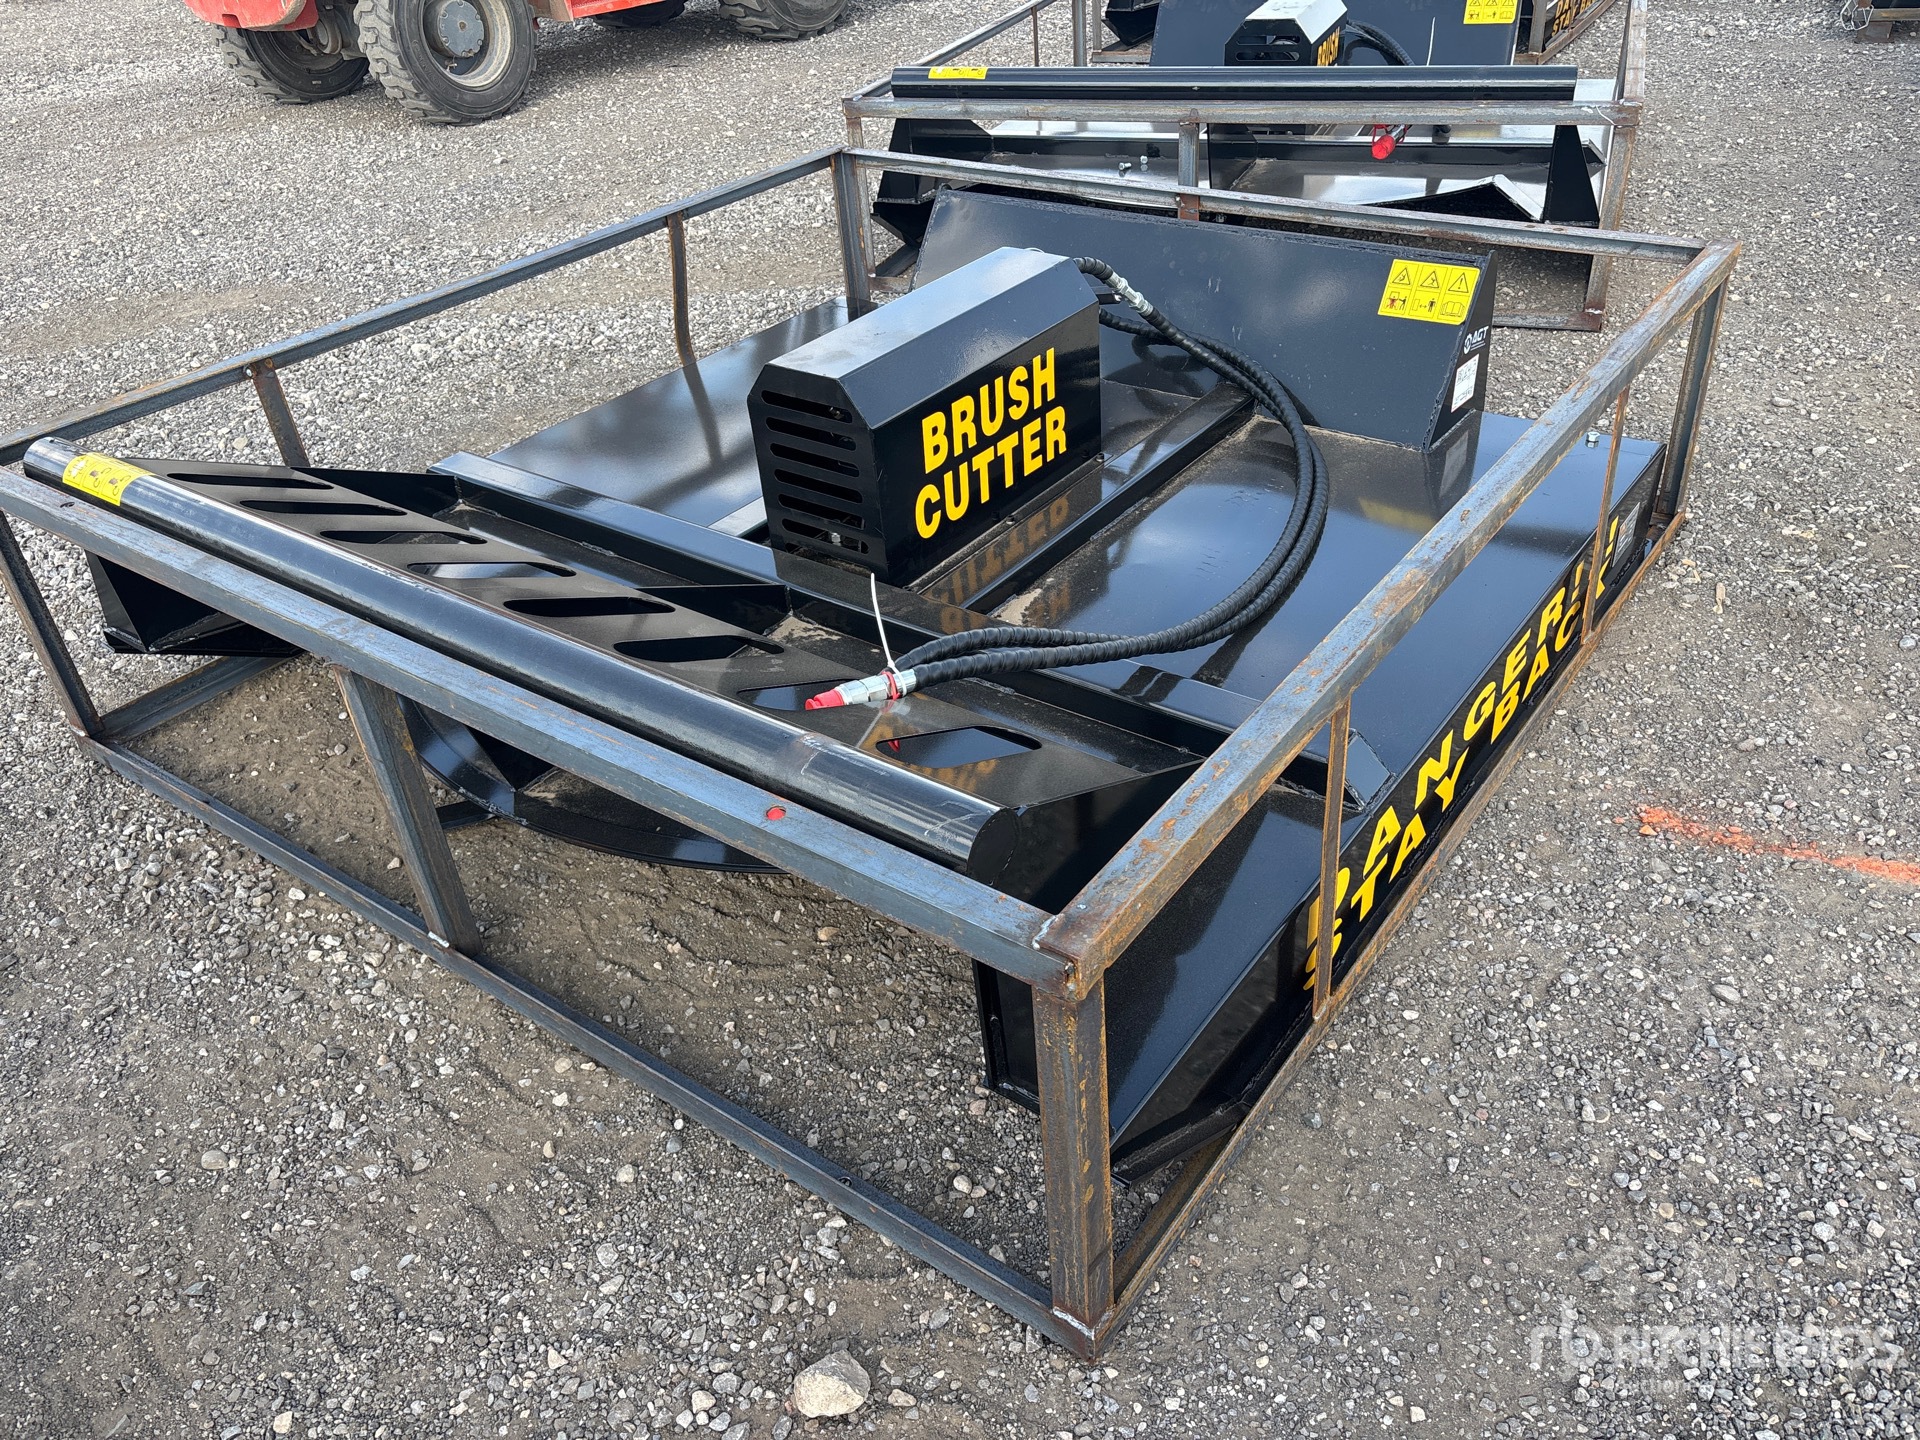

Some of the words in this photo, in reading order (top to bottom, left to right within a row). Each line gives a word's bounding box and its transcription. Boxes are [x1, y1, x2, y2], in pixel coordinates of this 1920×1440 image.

[1316, 26, 1340, 66] BRUSH
[1472, 325, 1489, 344] AGT
[922, 347, 1055, 475] BRUSH
[915, 405, 1067, 539] CUTTER
